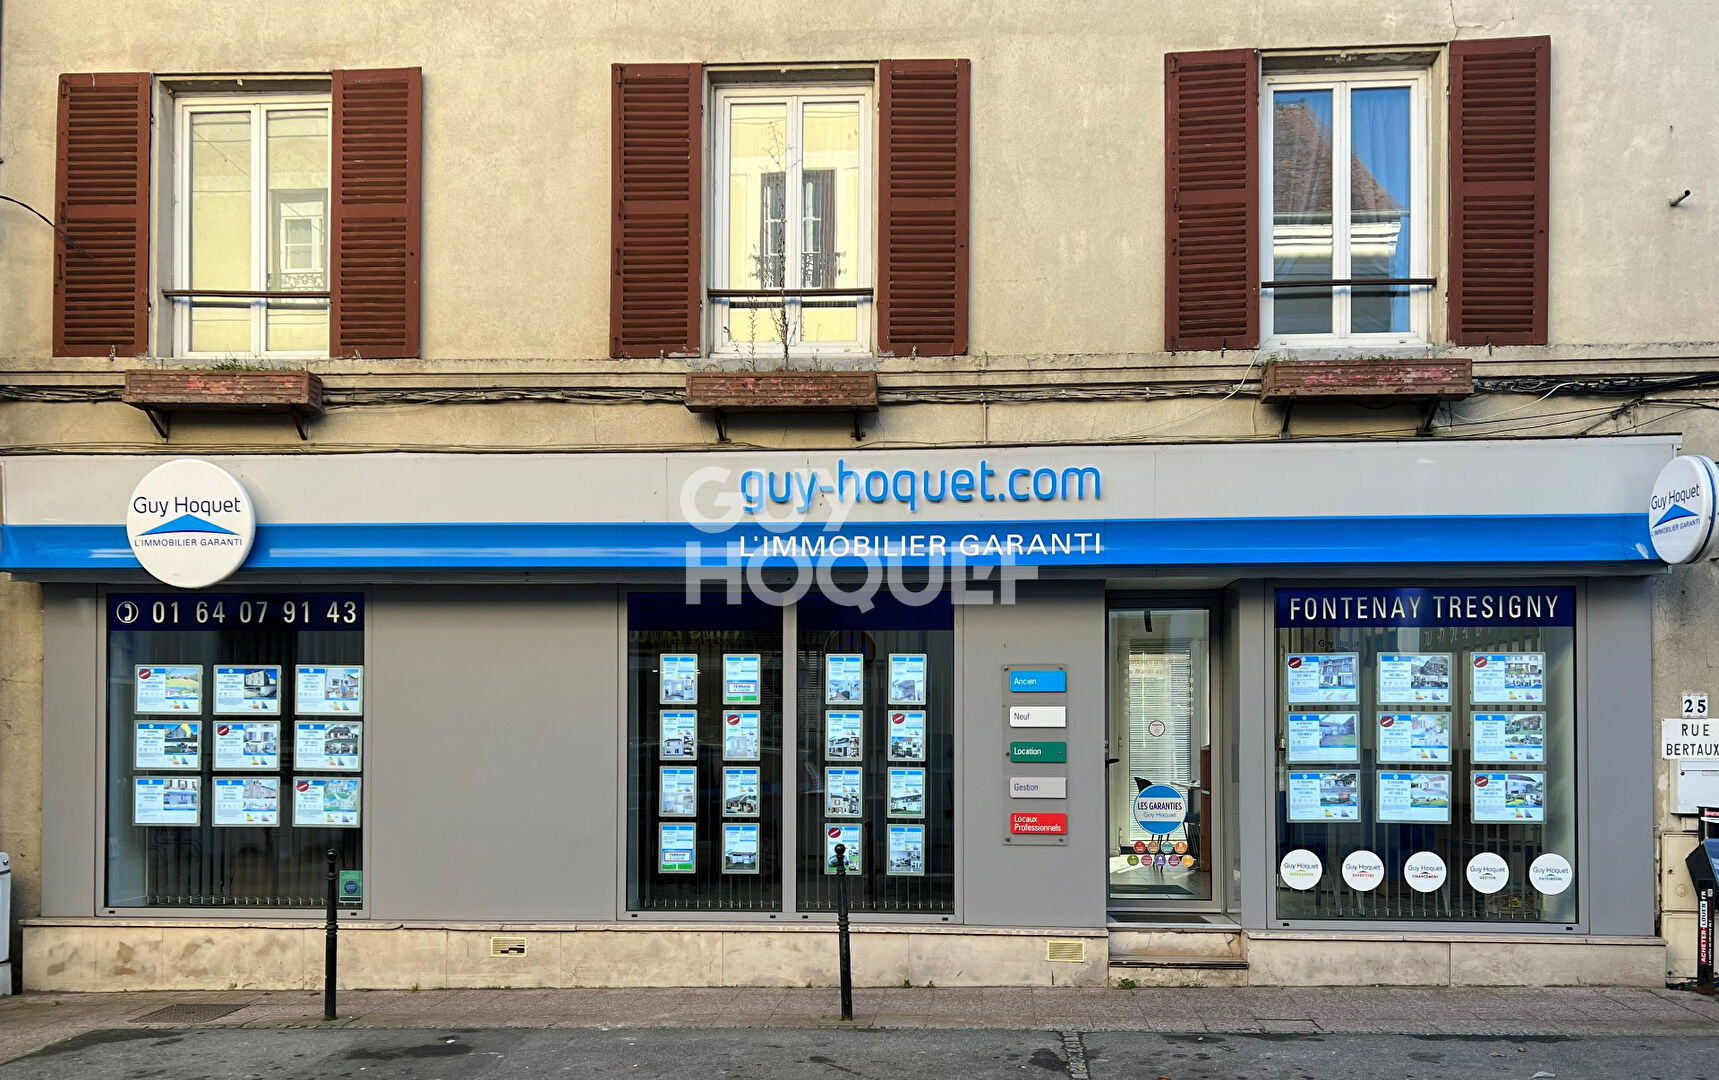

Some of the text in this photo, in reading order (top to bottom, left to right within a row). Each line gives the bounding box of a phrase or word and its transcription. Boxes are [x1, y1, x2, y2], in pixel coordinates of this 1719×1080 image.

[740, 460, 1101, 512] guy-hoquet.com
[1650, 484, 1700, 510] Guy Hoquet
[133, 496, 241, 516] Guy Hoquet
[1680, 518, 1700, 530] GARANTI
[134, 538, 242, 546] L'IMMOBILIER GARANTI
[740, 532, 1101, 557] L'IMMOBILIER GARANTI
[152, 601, 357, 623] 01 64 07 91 43
[1290, 595, 1558, 620] FONTENAY TRESIGNY
[1014, 677, 1036, 685] Ancien
[1684, 699, 1706, 713] 25
[1014, 712, 1030, 721] Neuf
[1682, 724, 1710, 736] RUE
[1014, 746, 1042, 756] Location
[1666, 744, 1719, 756] BERTAUX
[1014, 783, 1039, 792] Gestion
[1138, 802, 1182, 810] LES GARANTIES
[1014, 815, 1038, 823] Locaux
[1014, 823, 1061, 832] Professionnels
